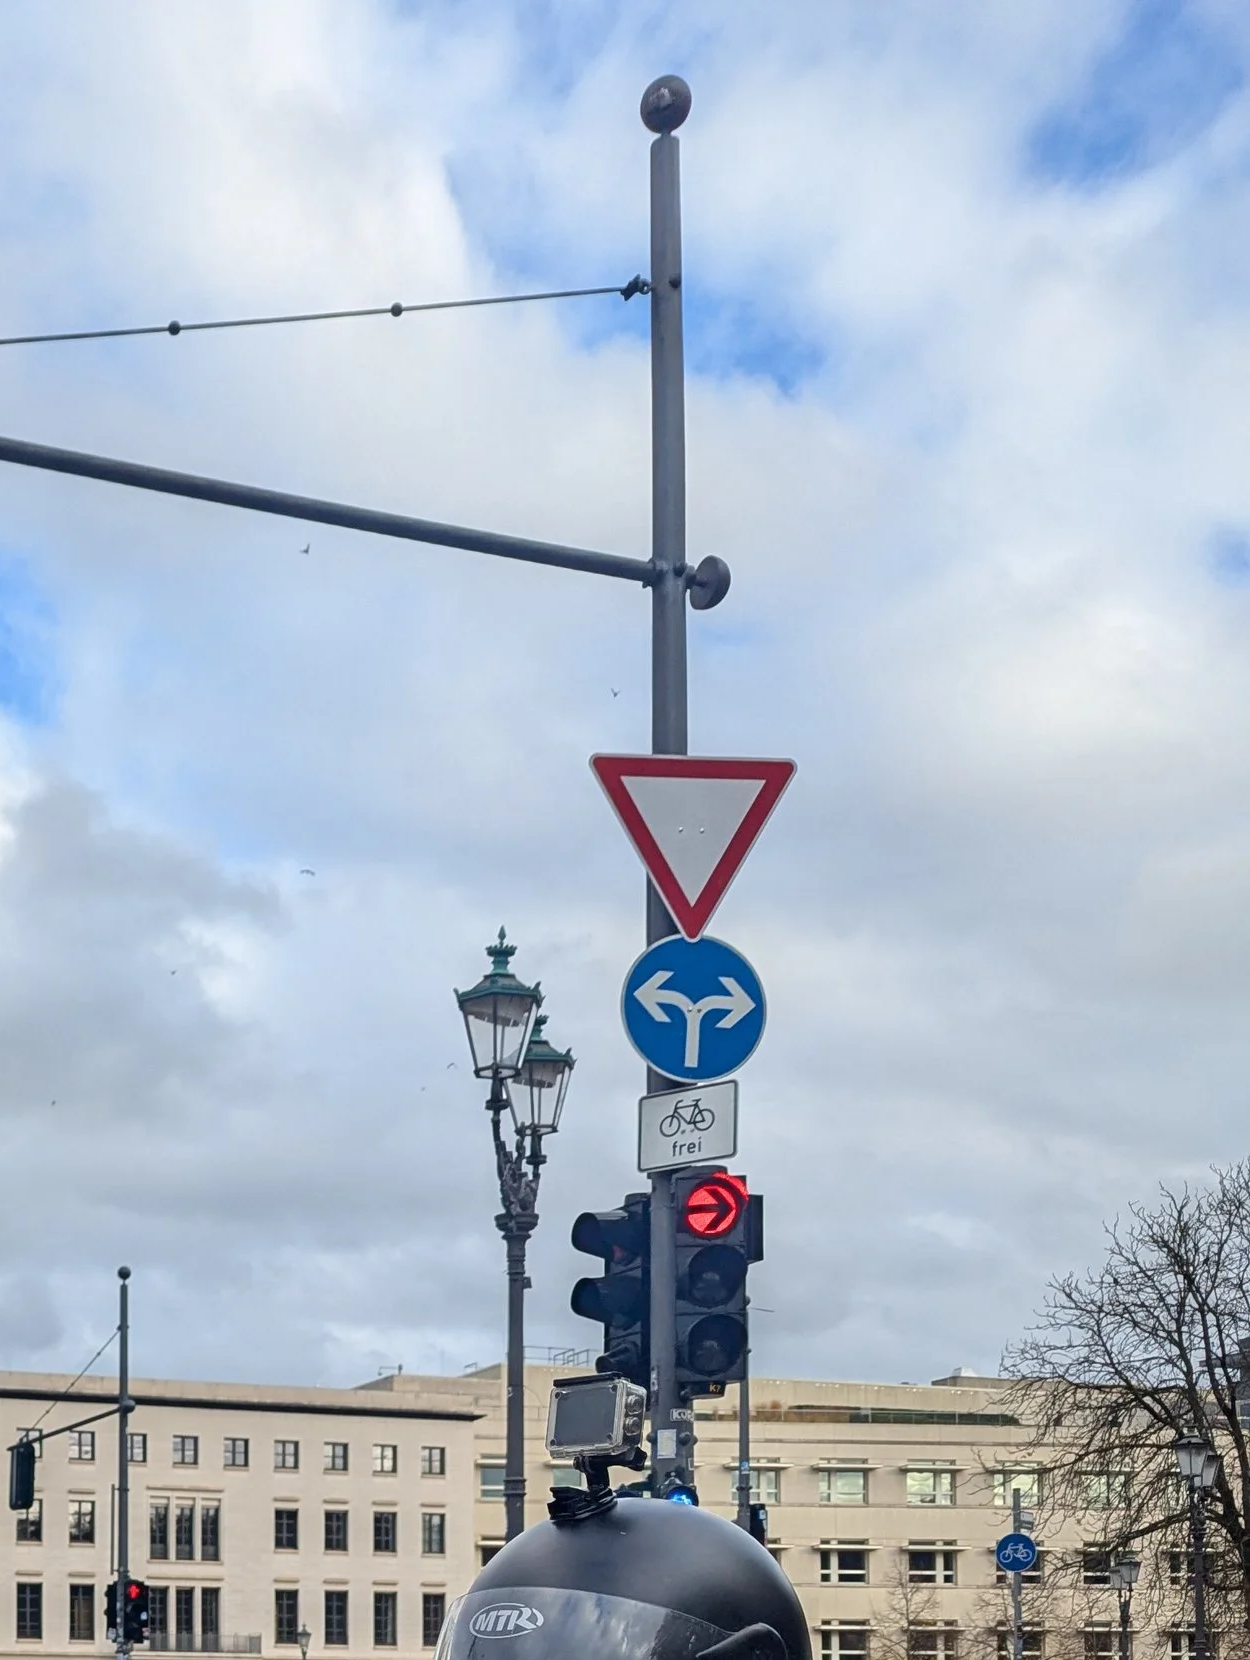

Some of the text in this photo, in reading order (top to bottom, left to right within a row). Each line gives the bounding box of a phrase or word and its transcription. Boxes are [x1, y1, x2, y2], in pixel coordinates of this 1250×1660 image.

[672, 1136, 703, 1157] frei
[710, 1384, 722, 1393] K7
[474, 1607, 538, 1632] MTR
